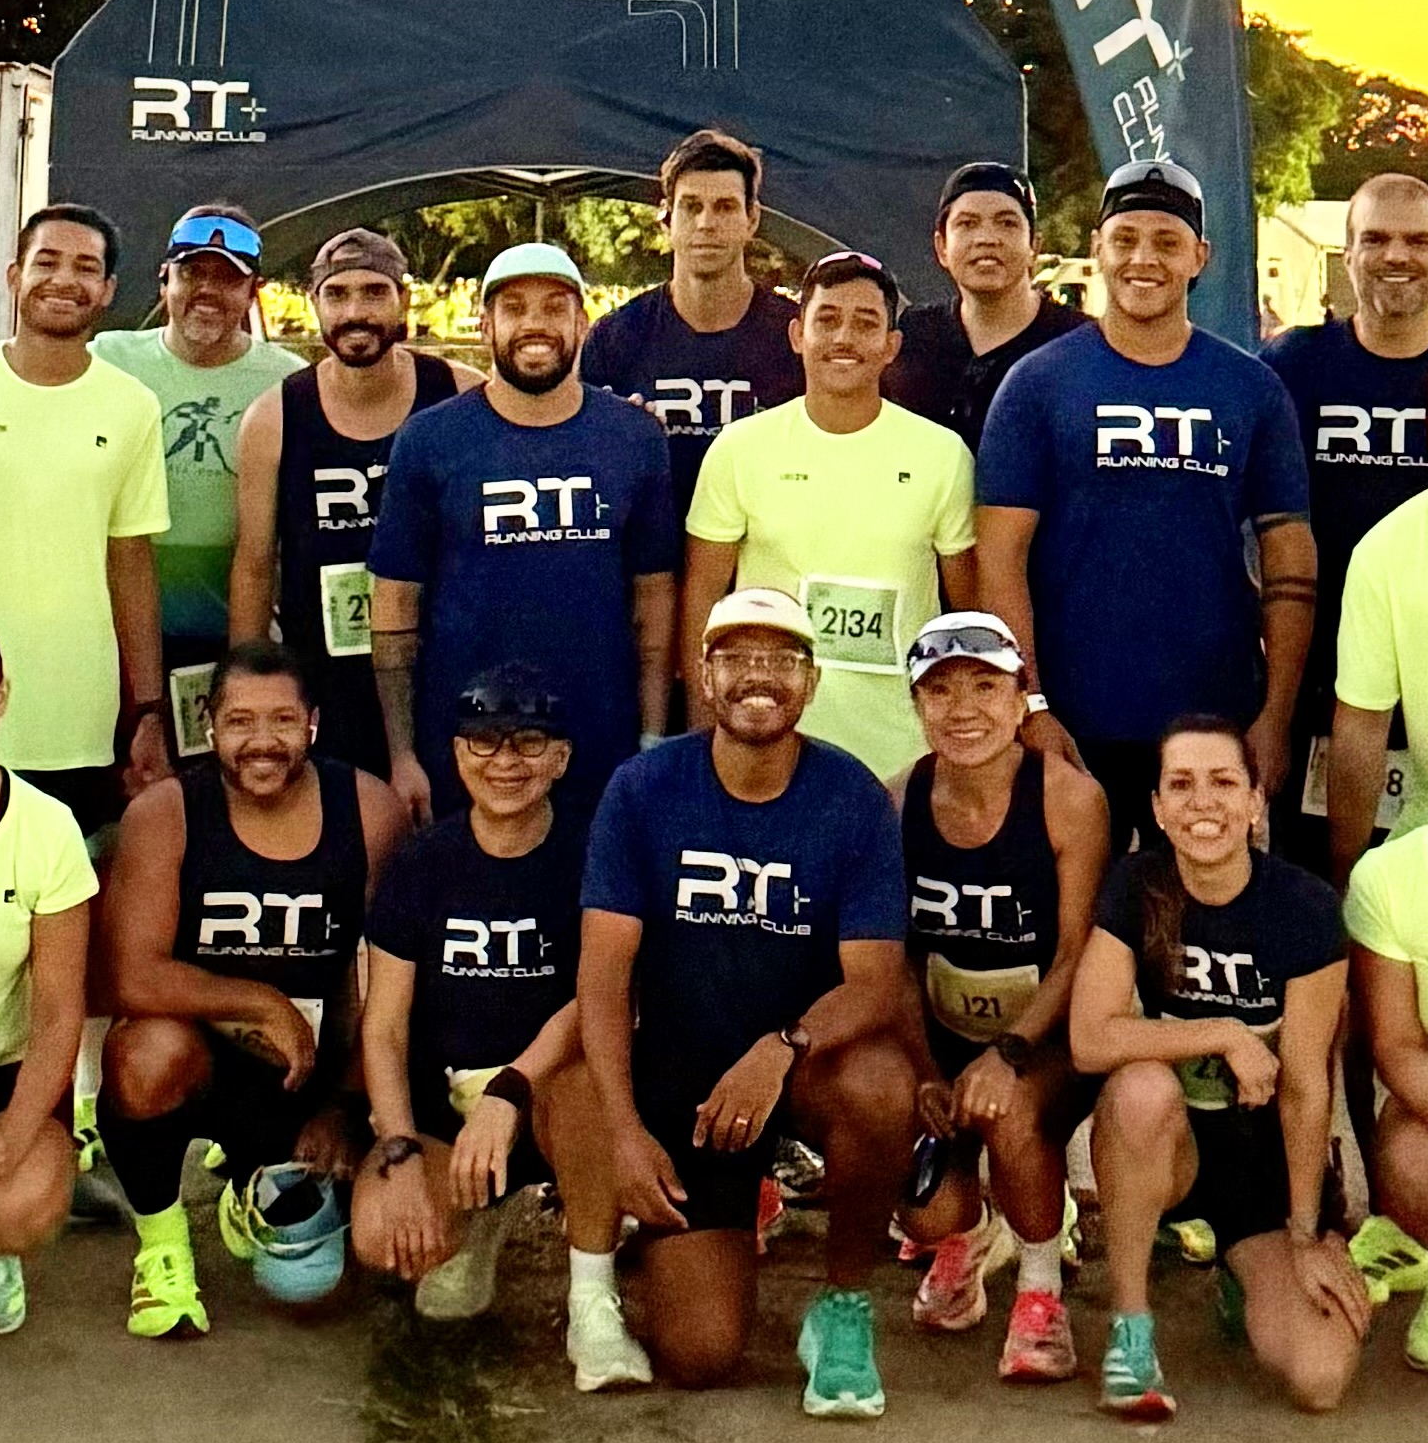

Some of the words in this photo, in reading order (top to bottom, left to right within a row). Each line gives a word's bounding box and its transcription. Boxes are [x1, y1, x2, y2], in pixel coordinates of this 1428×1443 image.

[132, 129, 213, 142] RUNNING
[216, 131, 267, 142] CLUB
[1097, 456, 1180, 469] RUNNING
[1183, 459, 1229, 476] CLUB
[1315, 452, 1393, 466] RUNNING
[318, 517, 378, 530] RUNNIN
[484, 529, 563, 546] RUNNING
[565, 528, 611, 540] CLUB
[820, 605, 883, 639] 2134
[676, 910, 758, 925] RUNNING
[760, 919, 811, 935] CLUB
